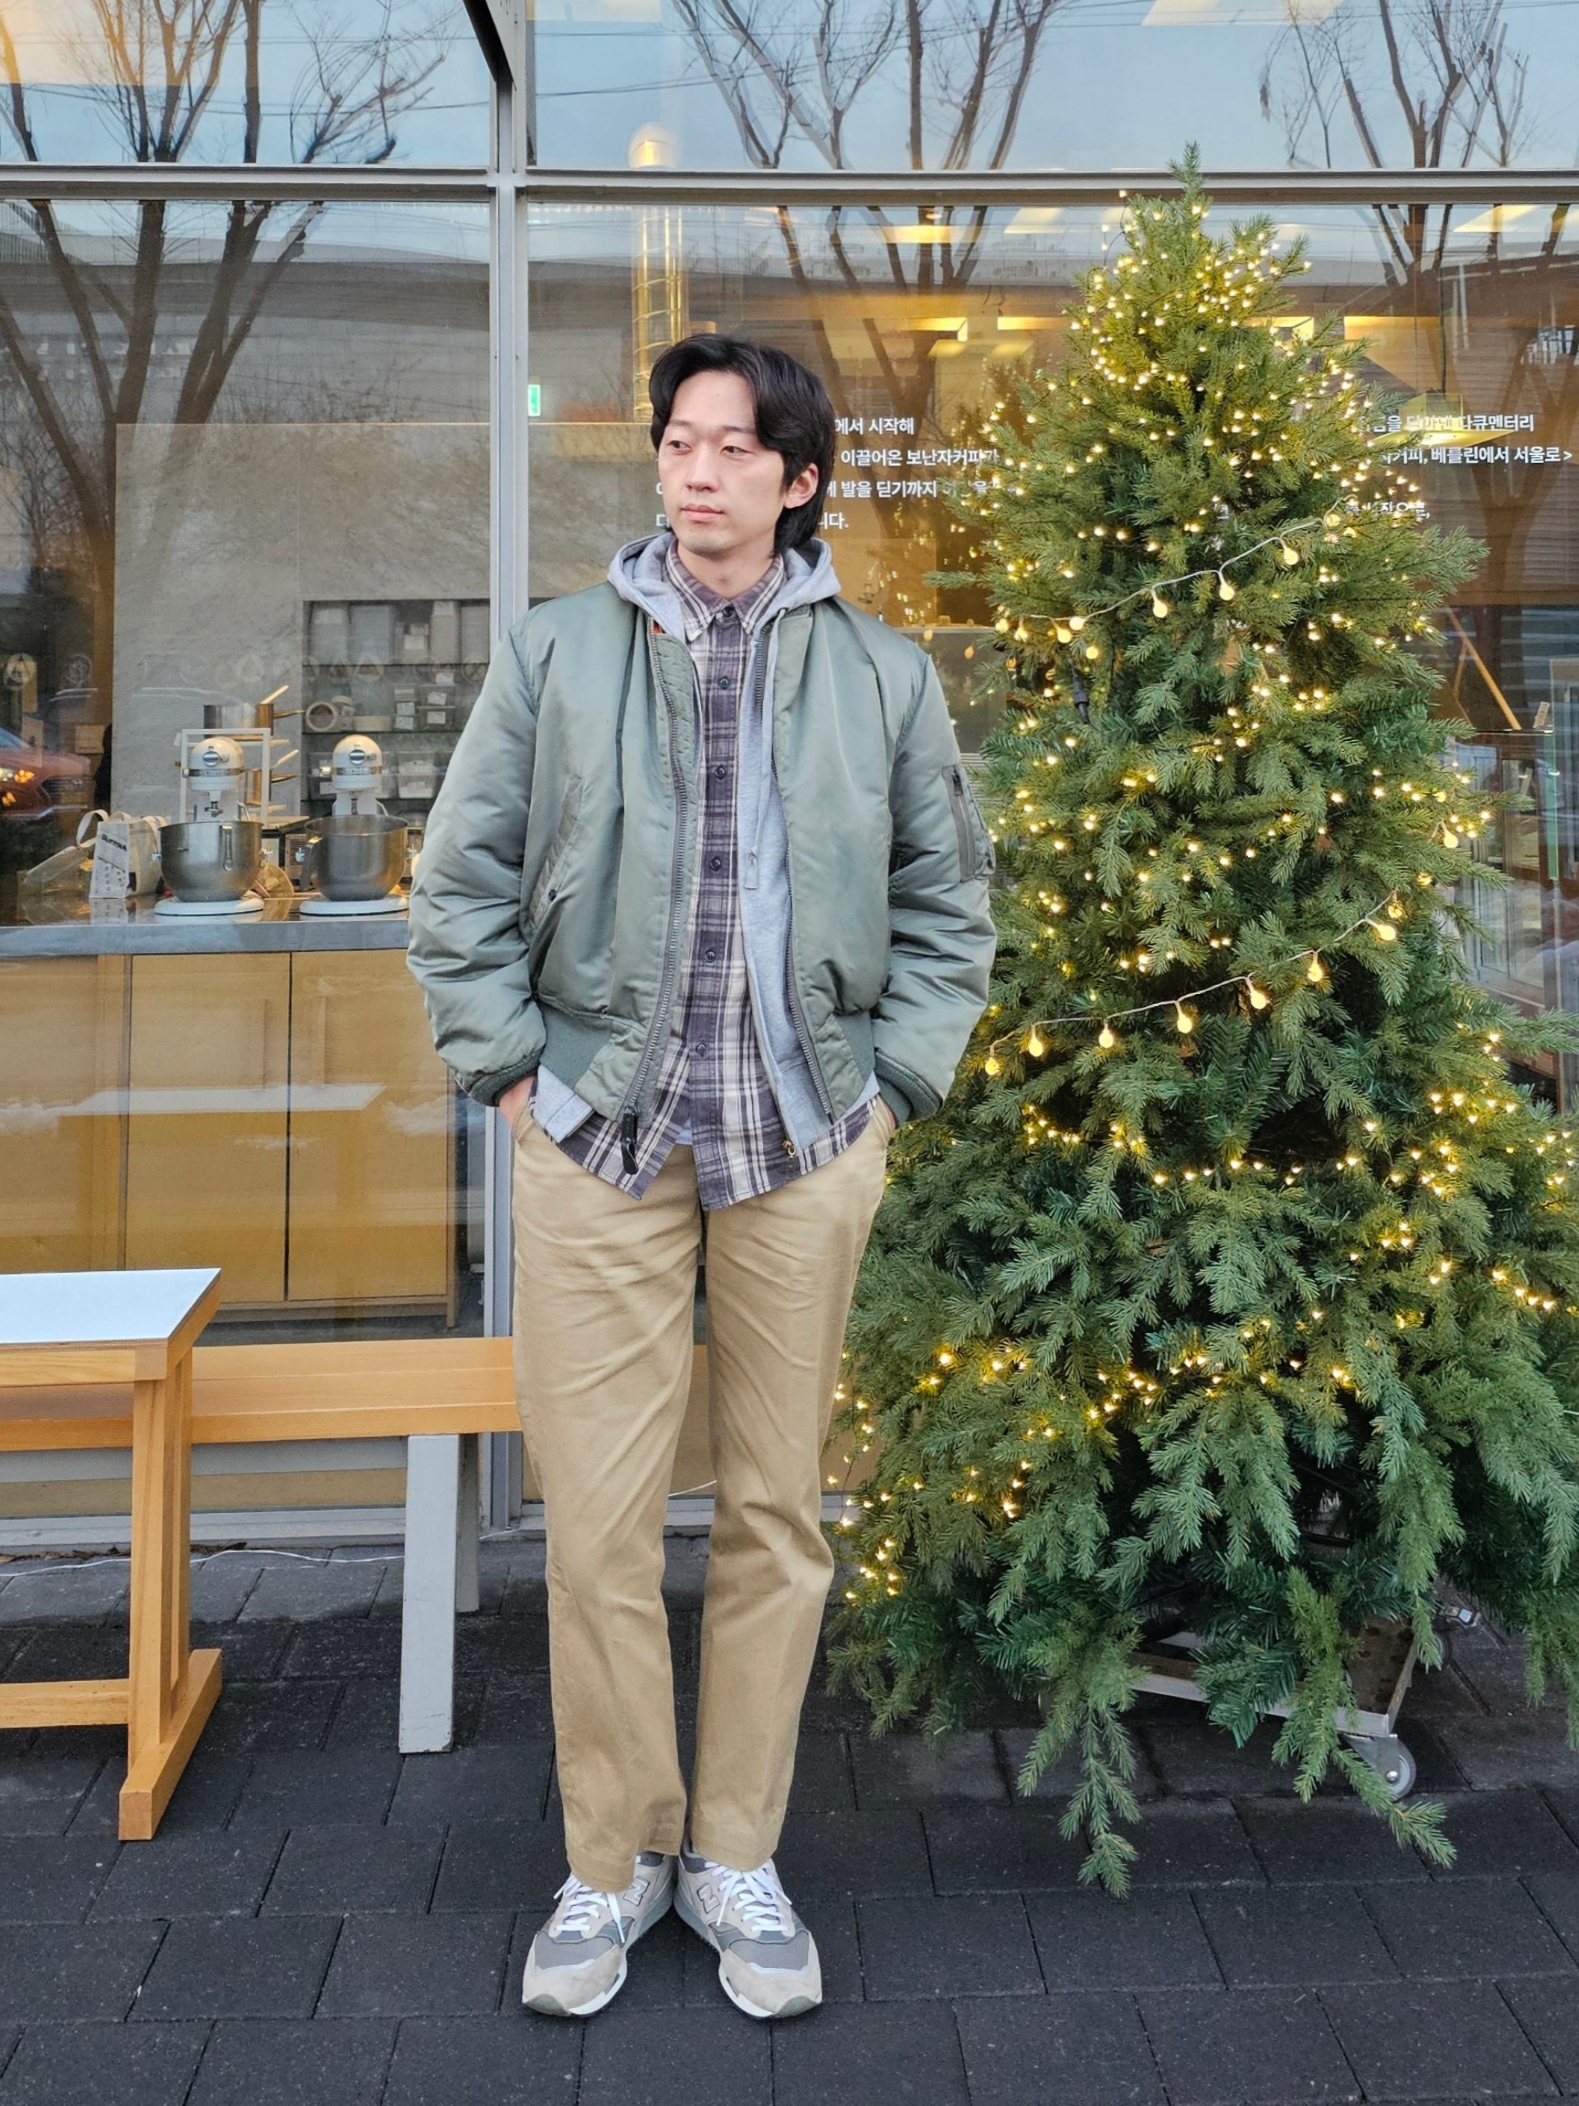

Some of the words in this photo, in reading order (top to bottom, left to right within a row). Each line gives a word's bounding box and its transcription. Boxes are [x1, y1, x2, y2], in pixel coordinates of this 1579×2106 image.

[868, 417, 915, 436] 시작해
[1459, 414, 1534, 432] 다큐멘터리
[841, 449, 903, 467] 이끌어온
[1431, 446, 1509, 464] 베를린에서
[841, 481, 872, 498] 발을
[876, 481, 938, 498] 딛기까지
